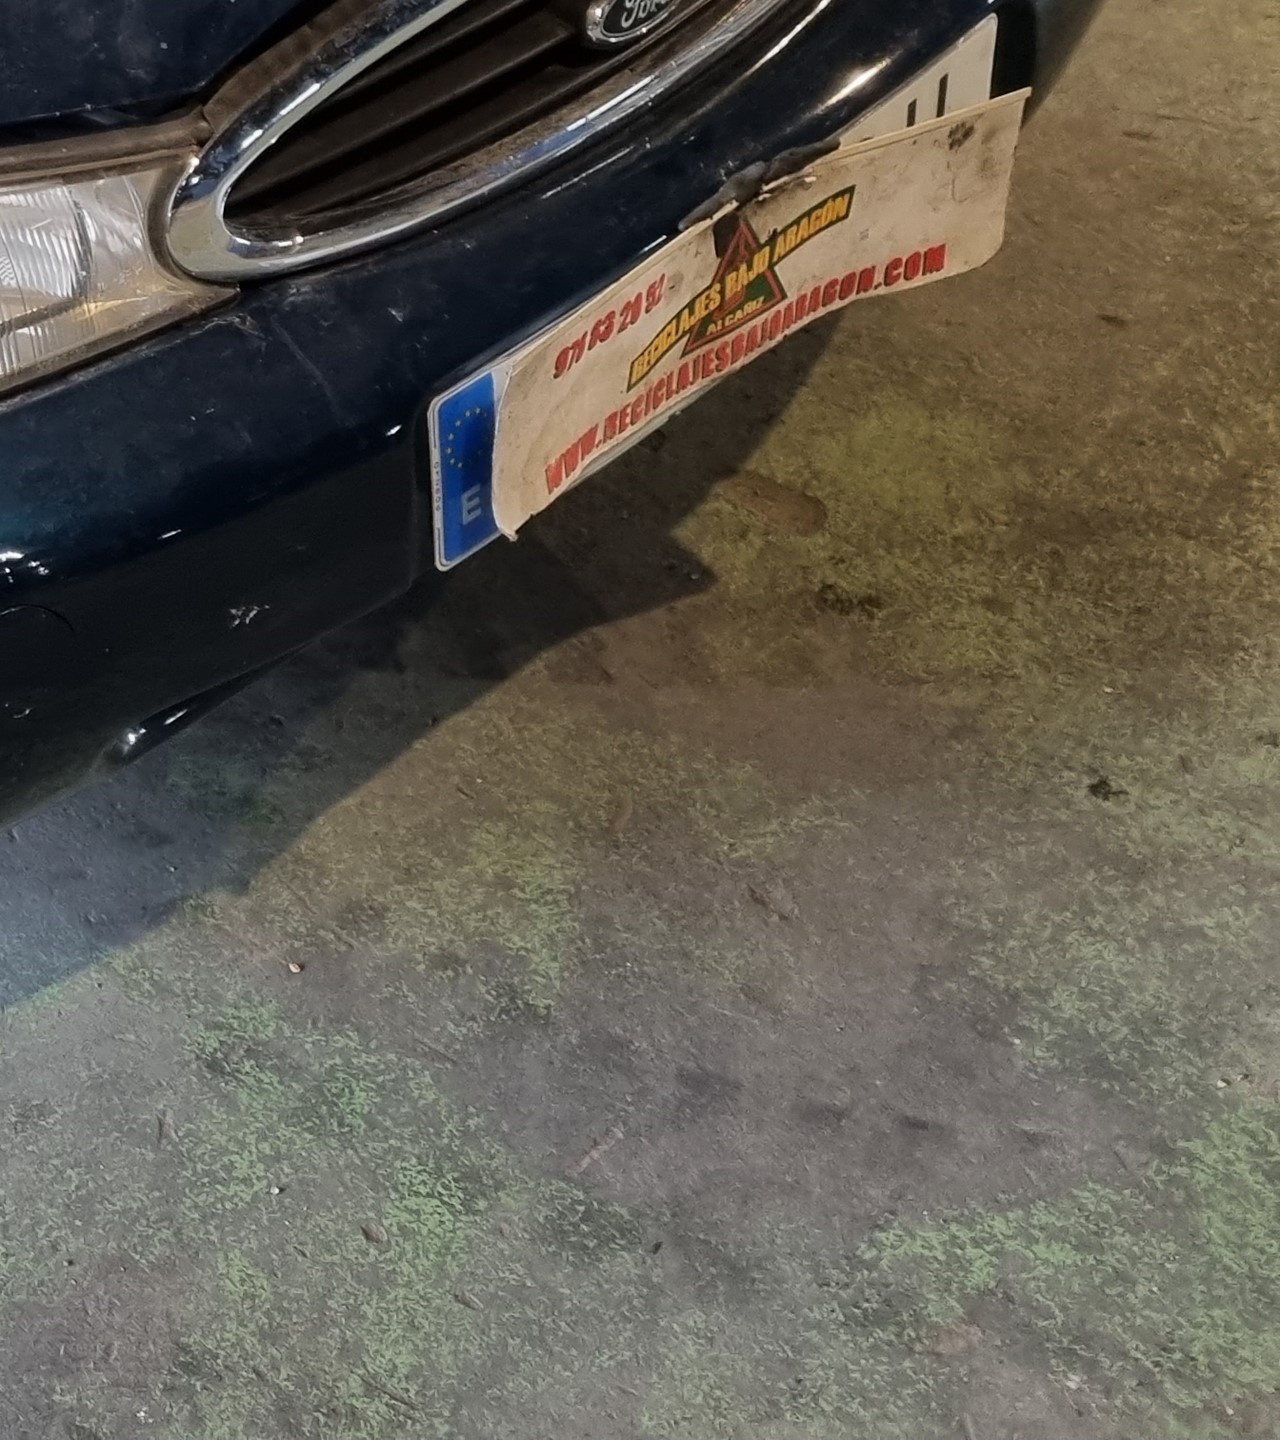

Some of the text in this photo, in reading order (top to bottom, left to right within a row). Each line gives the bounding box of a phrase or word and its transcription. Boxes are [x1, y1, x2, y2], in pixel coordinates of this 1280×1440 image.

[631, 282, 721, 382] RECICLAJES
[725, 245, 770, 296] BAJO
[461, 483, 482, 525] E
